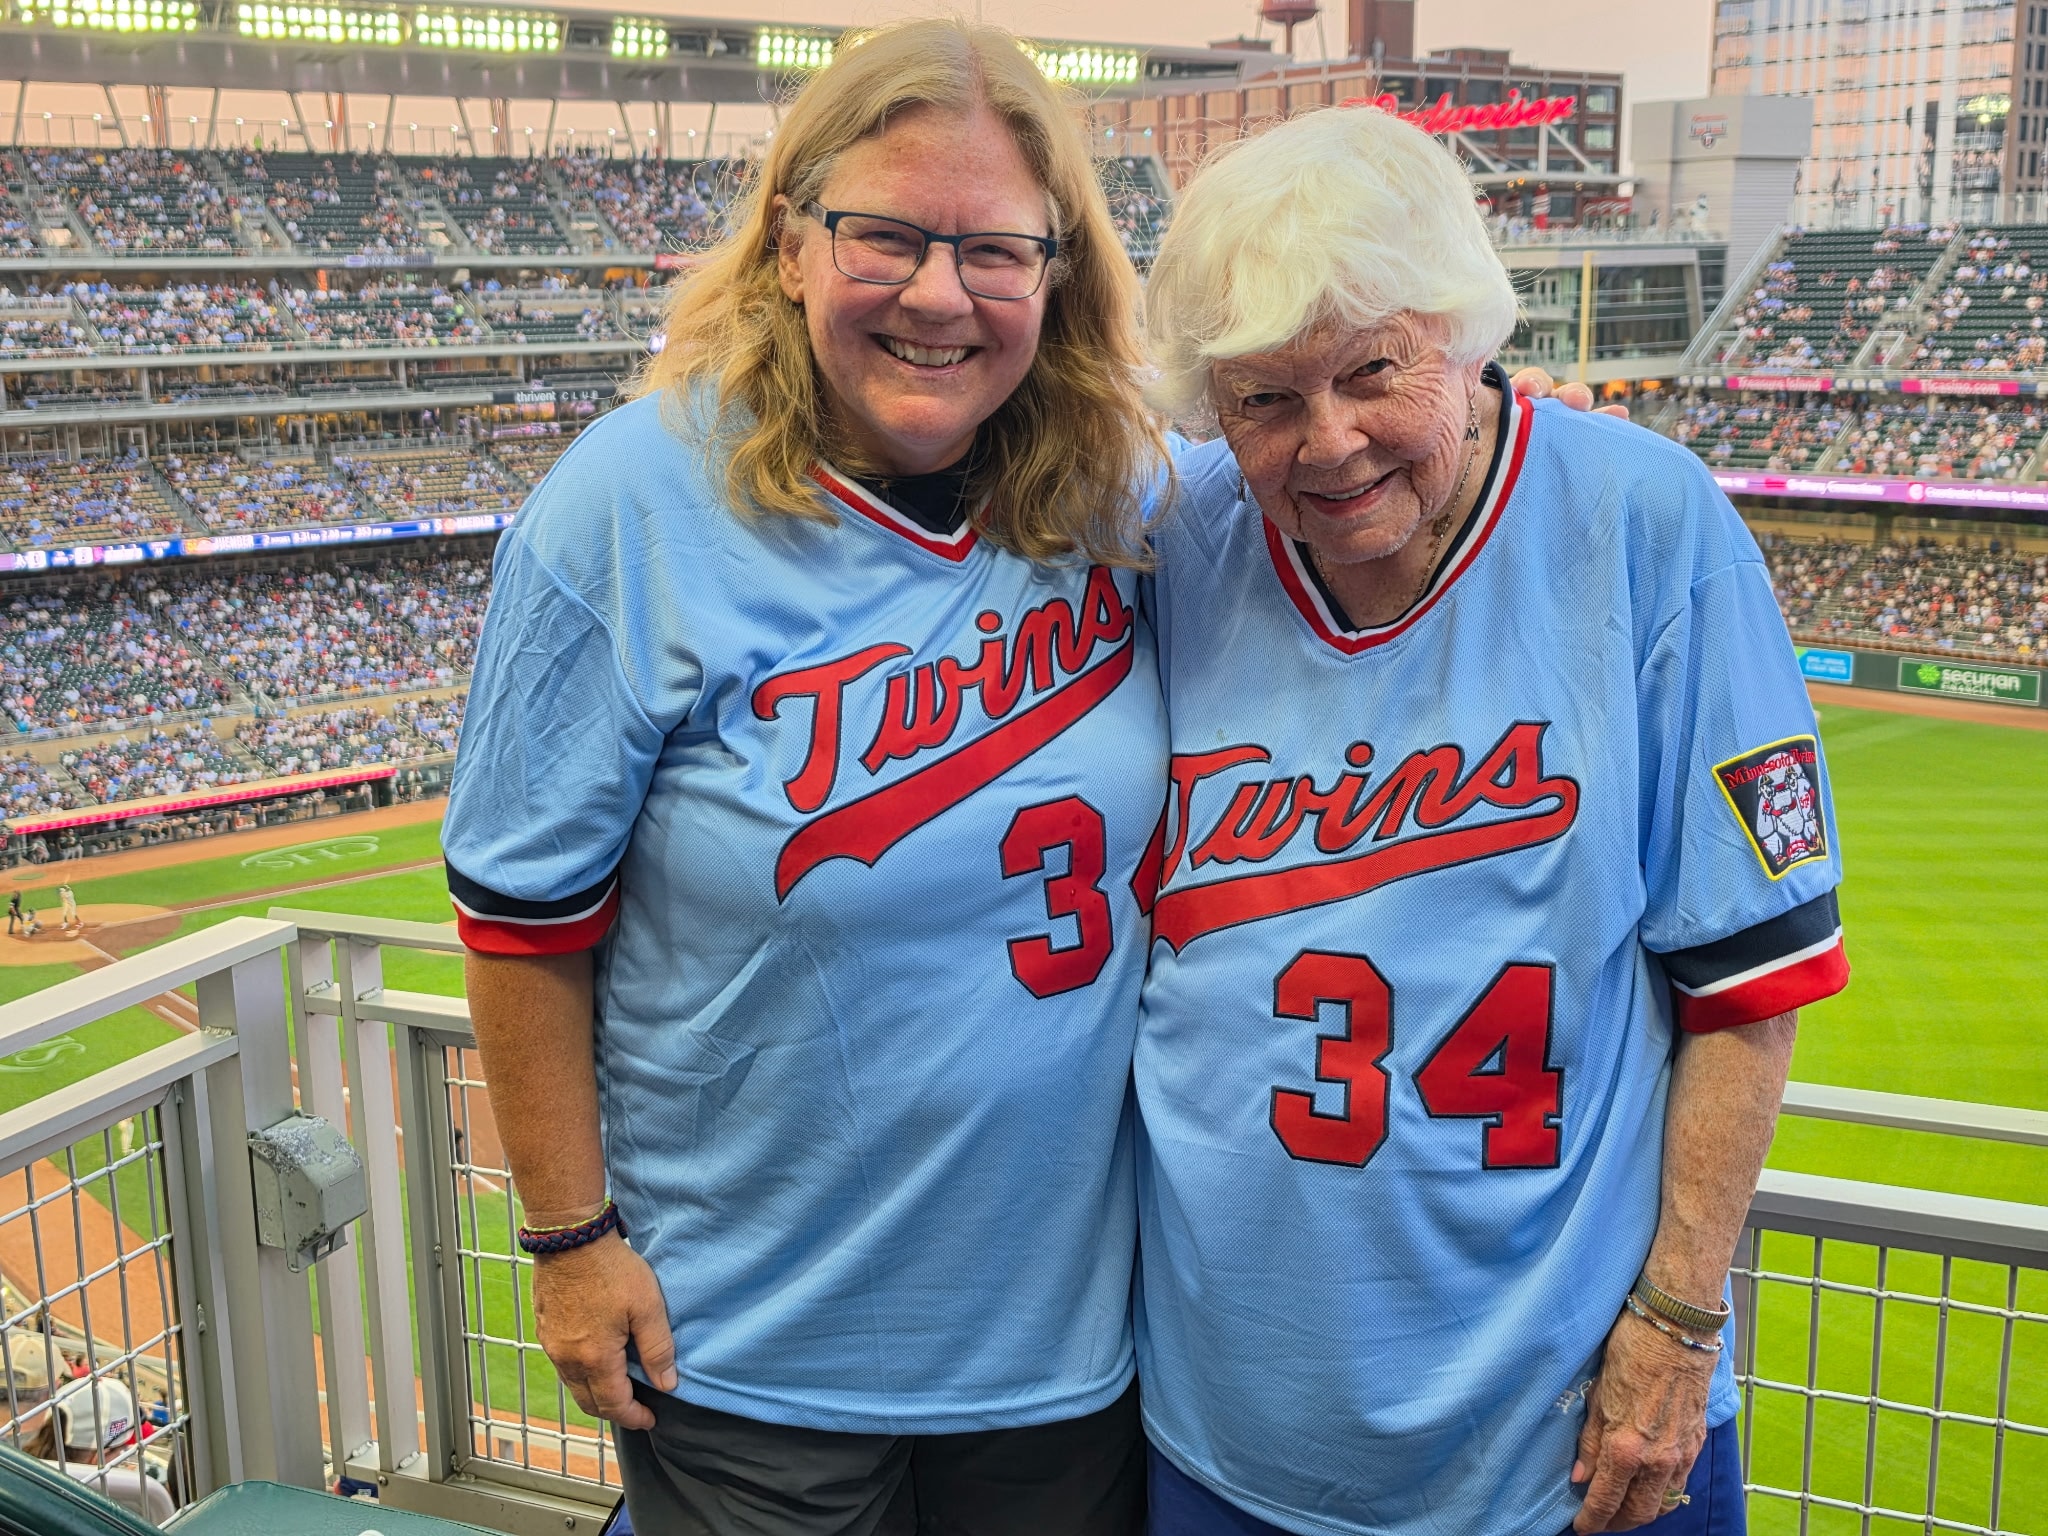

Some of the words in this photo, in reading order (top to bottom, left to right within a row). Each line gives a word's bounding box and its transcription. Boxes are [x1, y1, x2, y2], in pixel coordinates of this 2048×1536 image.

[515, 390, 556, 403] thrivent
[1739, 376, 1786, 391] Treasure
[1787, 377, 1821, 392] Island
[751, 564, 1135, 814] Twins
[1940, 682, 1997, 696] FINANCIAL
[1941, 668, 2021, 692] securian
[1723, 755, 1793, 790] Minnesota
[1158, 718, 1570, 888] Twins
[1269, 947, 1566, 1170] 34
